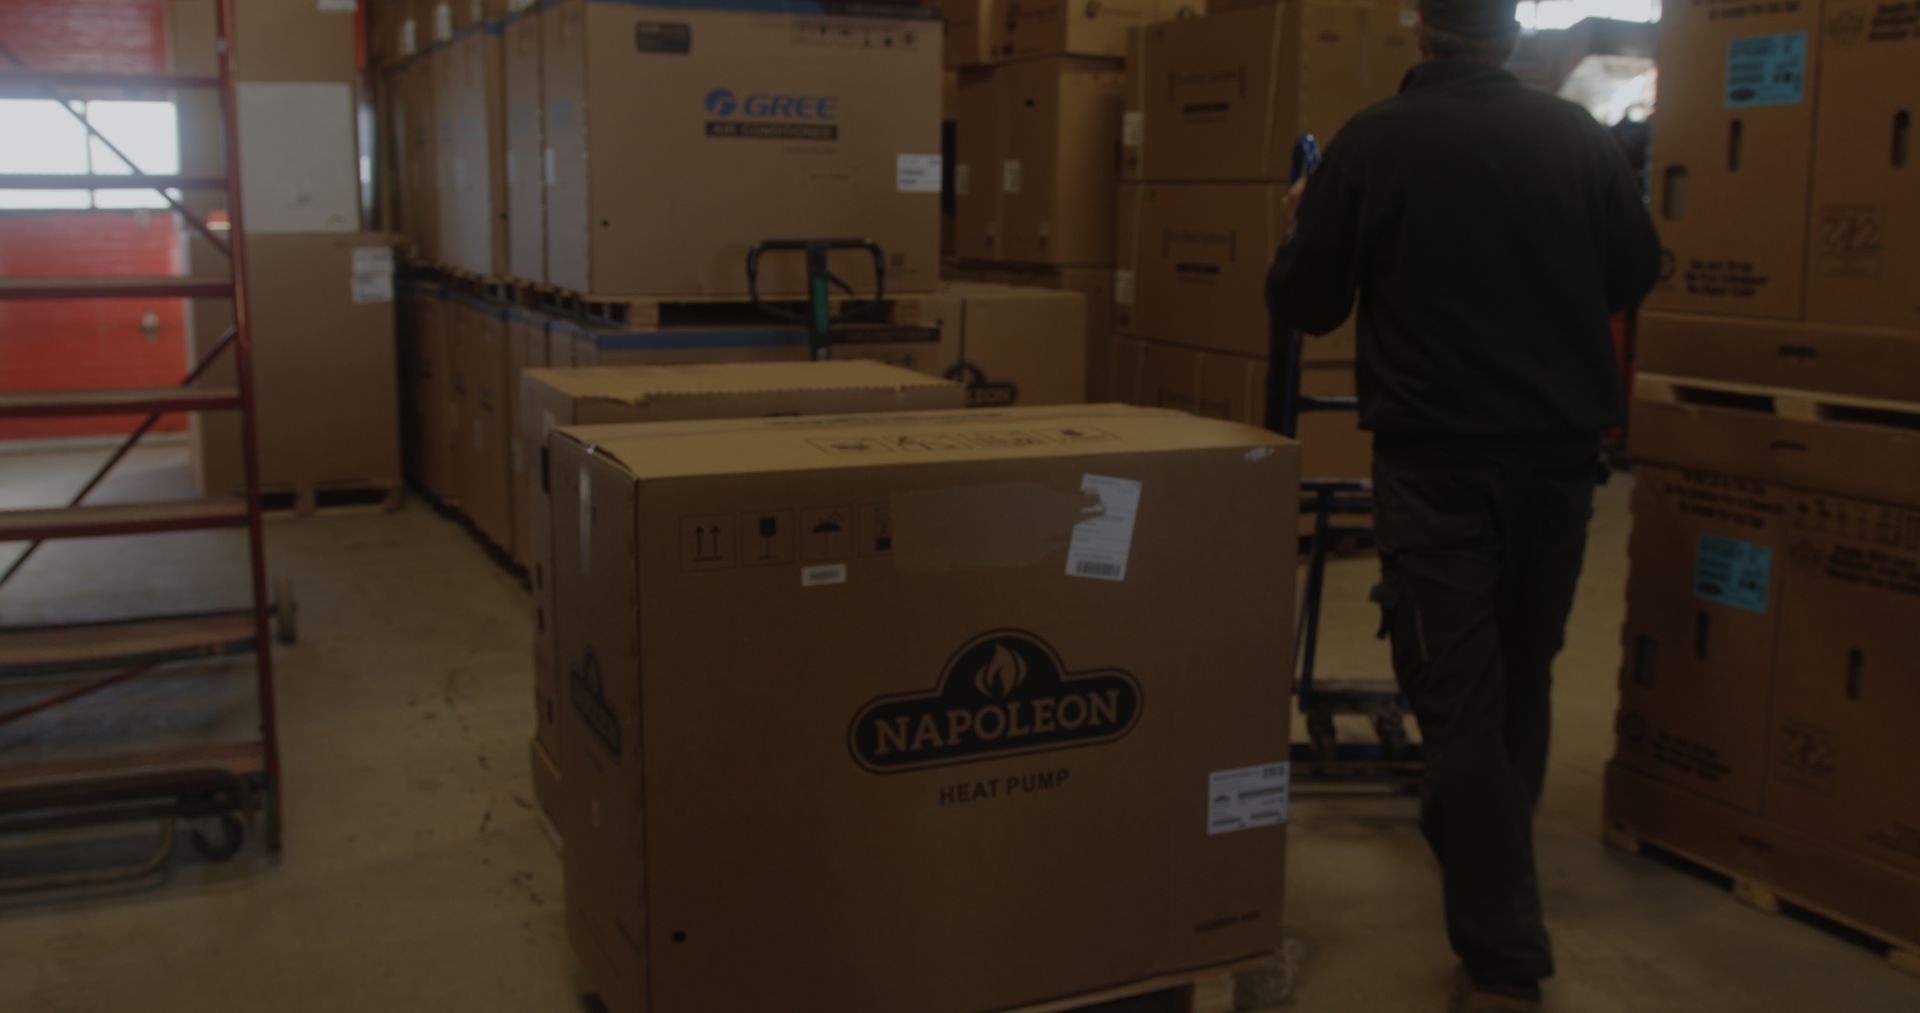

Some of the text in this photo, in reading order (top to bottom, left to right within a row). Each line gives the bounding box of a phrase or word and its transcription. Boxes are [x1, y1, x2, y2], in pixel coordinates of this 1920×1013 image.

[744, 95, 839, 119] GREE
[711, 124, 735, 136] AIR
[873, 689, 1121, 757] NAPOLEON
[939, 769, 1070, 806] HEAT PUMP
